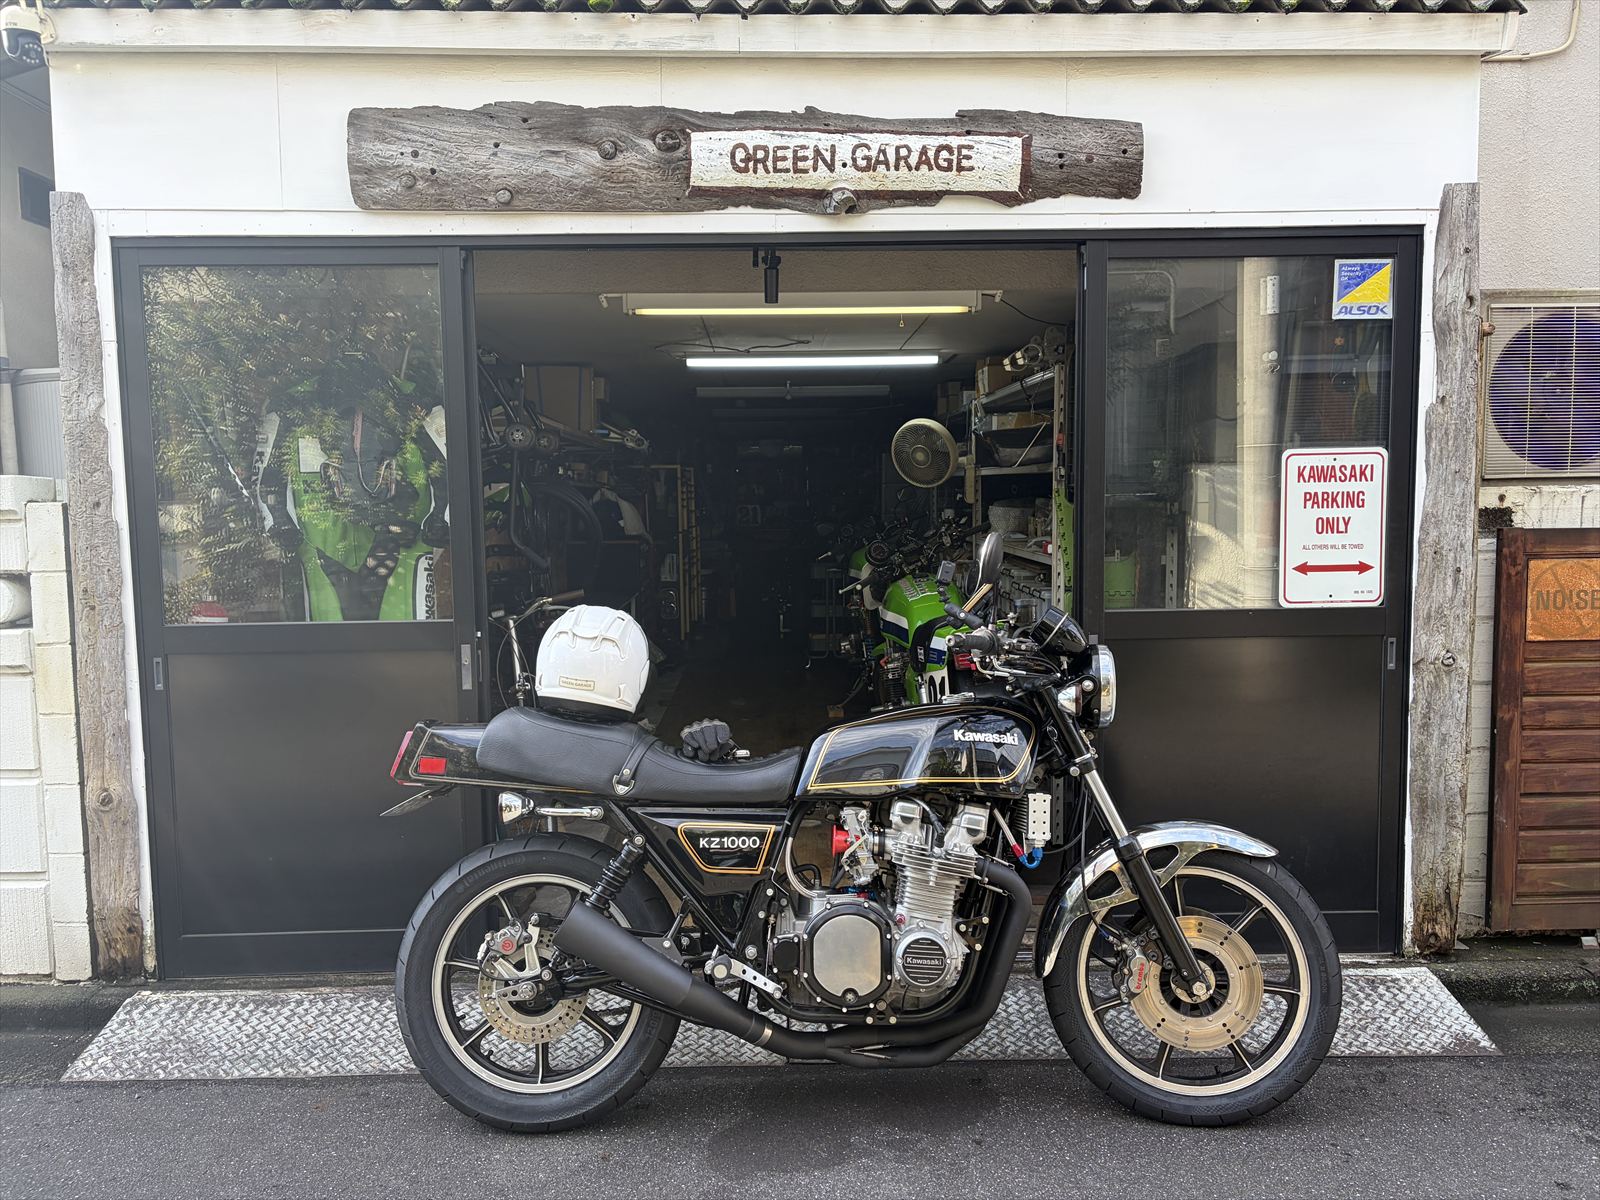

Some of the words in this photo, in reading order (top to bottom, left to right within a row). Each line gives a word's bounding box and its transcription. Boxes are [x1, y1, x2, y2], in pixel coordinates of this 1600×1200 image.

[729, 143, 837, 174] GREEN
[850, 142, 976, 174] GARAGE
[1335, 305, 1389, 316] ALSOK
[1297, 464, 1375, 483] KAWASAKI
[1303, 490, 1366, 509] PARKING
[1315, 516, 1352, 535] ONLY
[1311, 543, 1329, 551] OTHERS
[1535, 589, 1600, 611] NOISE
[953, 728, 1019, 745] Kawasaki
[699, 836, 760, 849] KZ1000
[463, 854, 527, 888] Continental
[906, 956, 942, 966] Kawasaki
[1134, 961, 1145, 990] brembo
